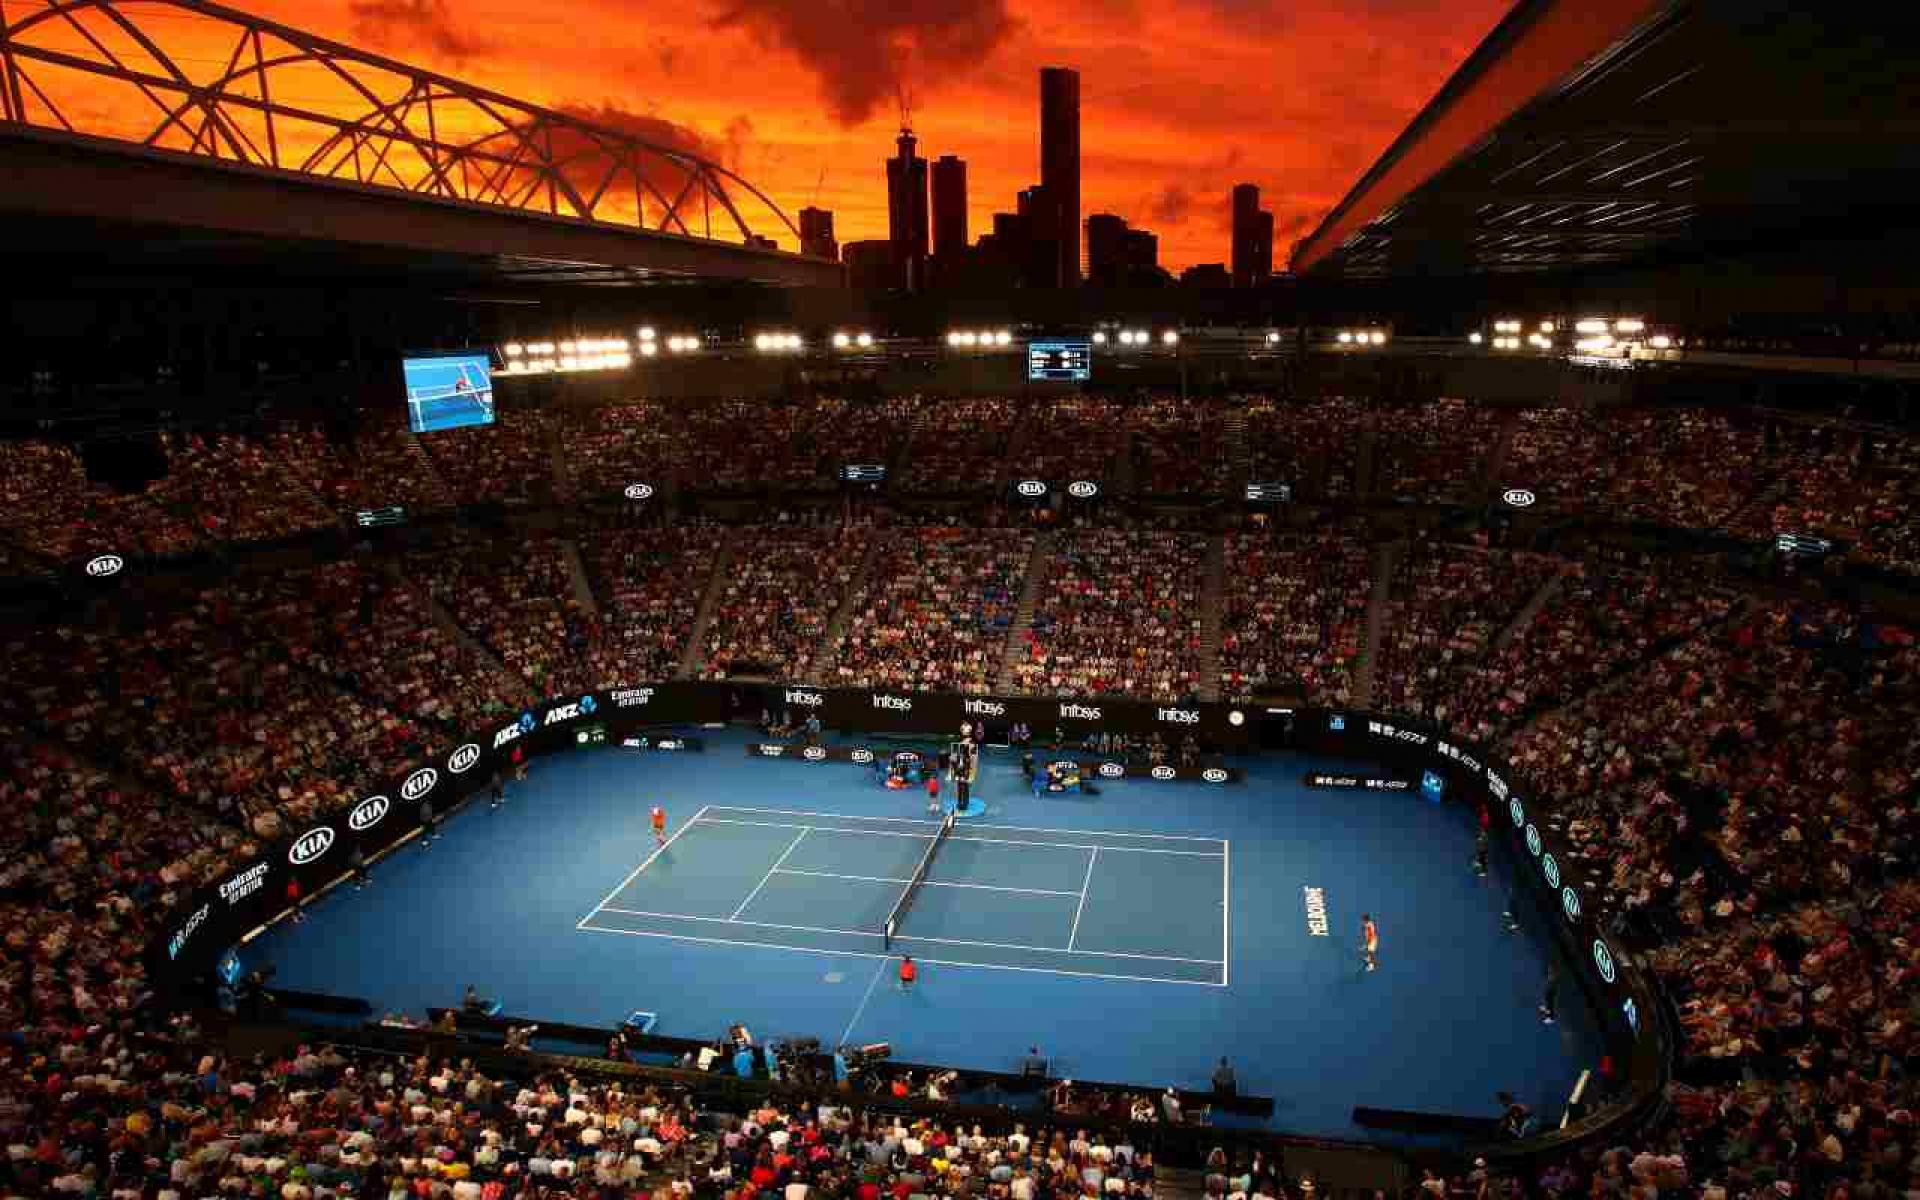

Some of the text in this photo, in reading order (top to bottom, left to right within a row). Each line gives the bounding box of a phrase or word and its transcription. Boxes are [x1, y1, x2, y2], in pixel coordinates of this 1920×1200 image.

[90, 557, 120, 574] KIA
[786, 690, 822, 707] Infosys
[873, 695, 912, 711] Infosys
[965, 699, 1005, 716] Infosys
[544, 703, 579, 726] ANZ
[1060, 703, 1101, 720] Infosys
[1159, 708, 1199, 724] Infosys
[493, 722, 520, 750] ANZ
[451, 746, 478, 771] KIA
[405, 770, 434, 797] KIA
[353, 798, 386, 827] KIA
[293, 831, 330, 861] KIA
